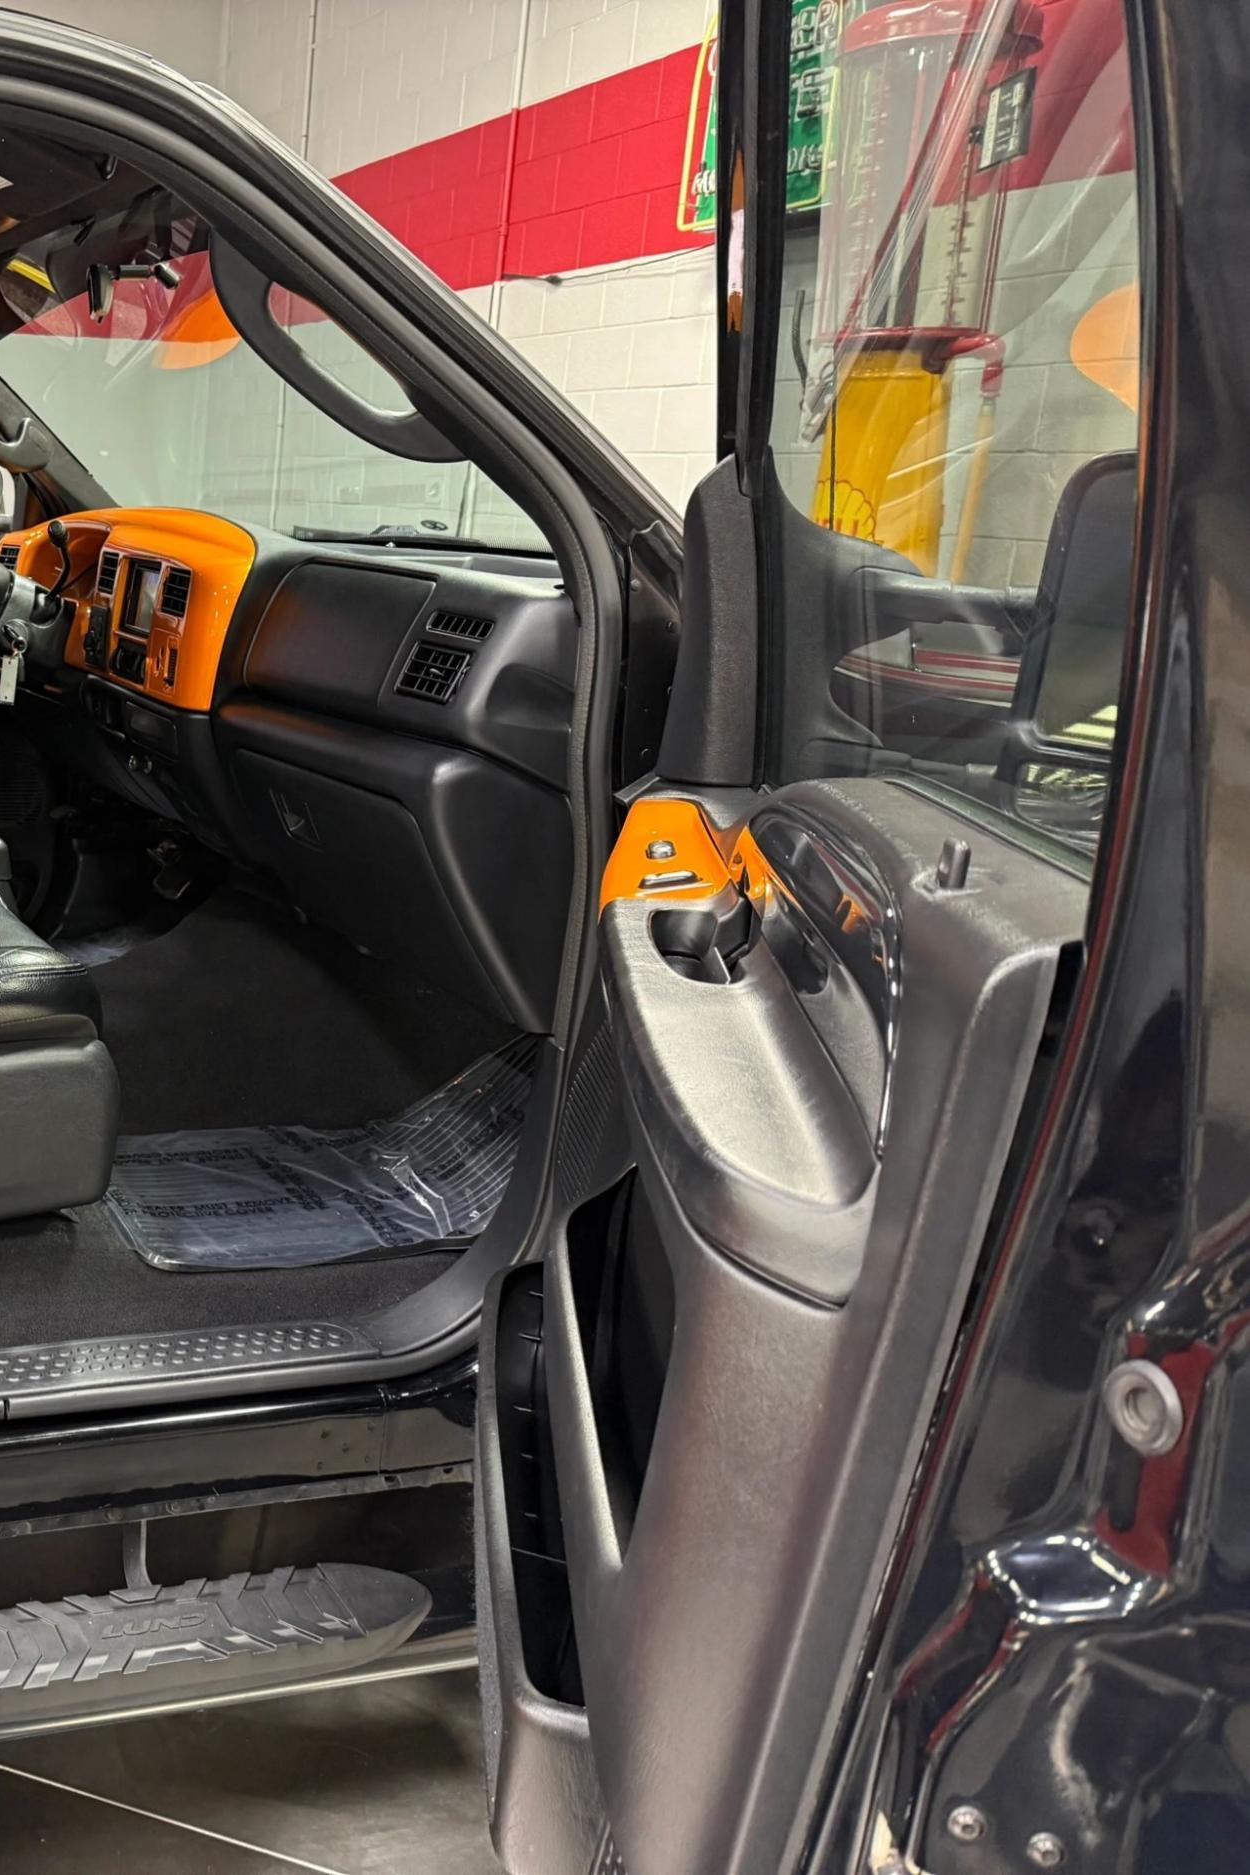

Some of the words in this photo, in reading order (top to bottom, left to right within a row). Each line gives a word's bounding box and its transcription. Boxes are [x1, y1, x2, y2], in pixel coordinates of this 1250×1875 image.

[193, 1202, 228, 1211] MUST
[224, 1206, 276, 1216] COVER
[101, 1613, 206, 1640] LUND
